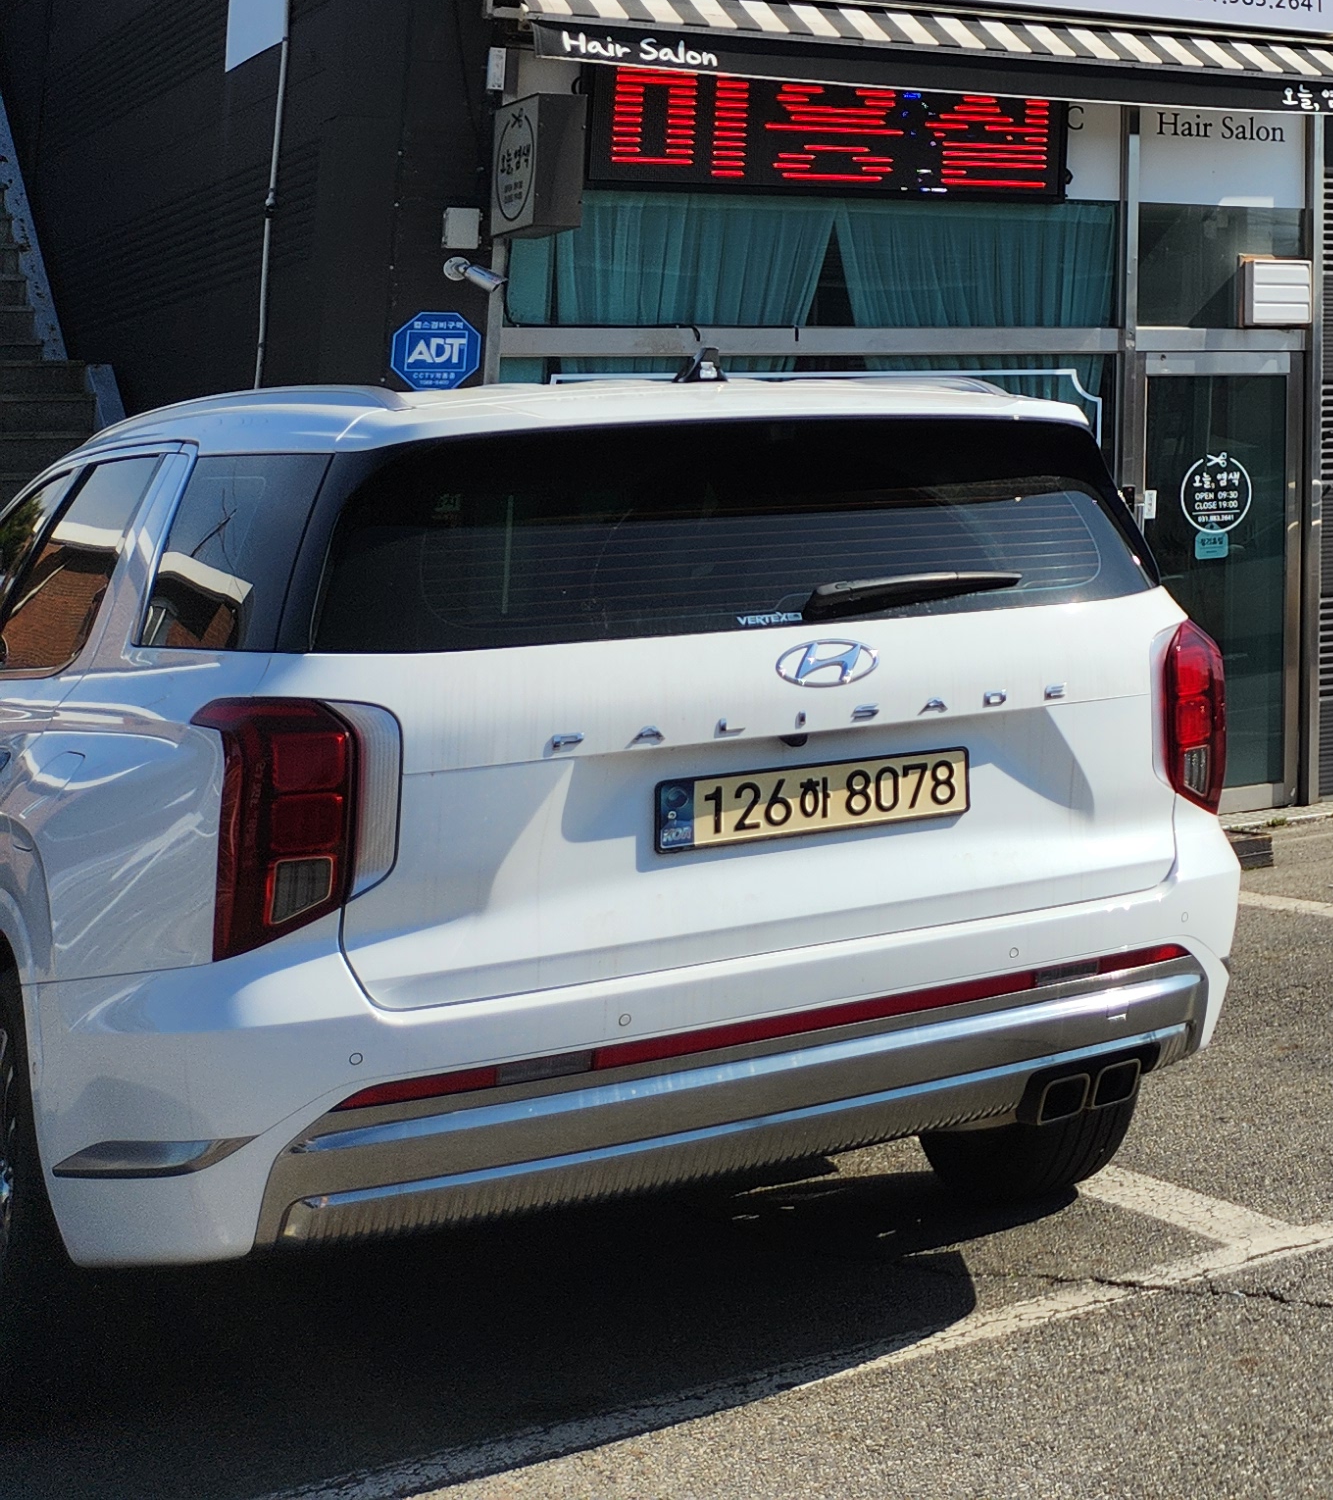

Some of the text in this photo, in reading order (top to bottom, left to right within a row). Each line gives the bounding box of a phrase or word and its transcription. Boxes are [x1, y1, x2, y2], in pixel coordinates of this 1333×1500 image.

[561, 30, 719, 69] Hair Salon
[1156, 110, 1287, 146] Hair Salon
[407, 337, 467, 363] ADT
[1217, 471, 1240, 487] 염색
[1195, 491, 1239, 500] OPEN 09:30
[1195, 500, 1239, 510] CLOSE 19:00
[551, 682, 1068, 751] PALISADE
[704, 760, 956, 835] 126하 8078
[662, 825, 692, 843] KOR
